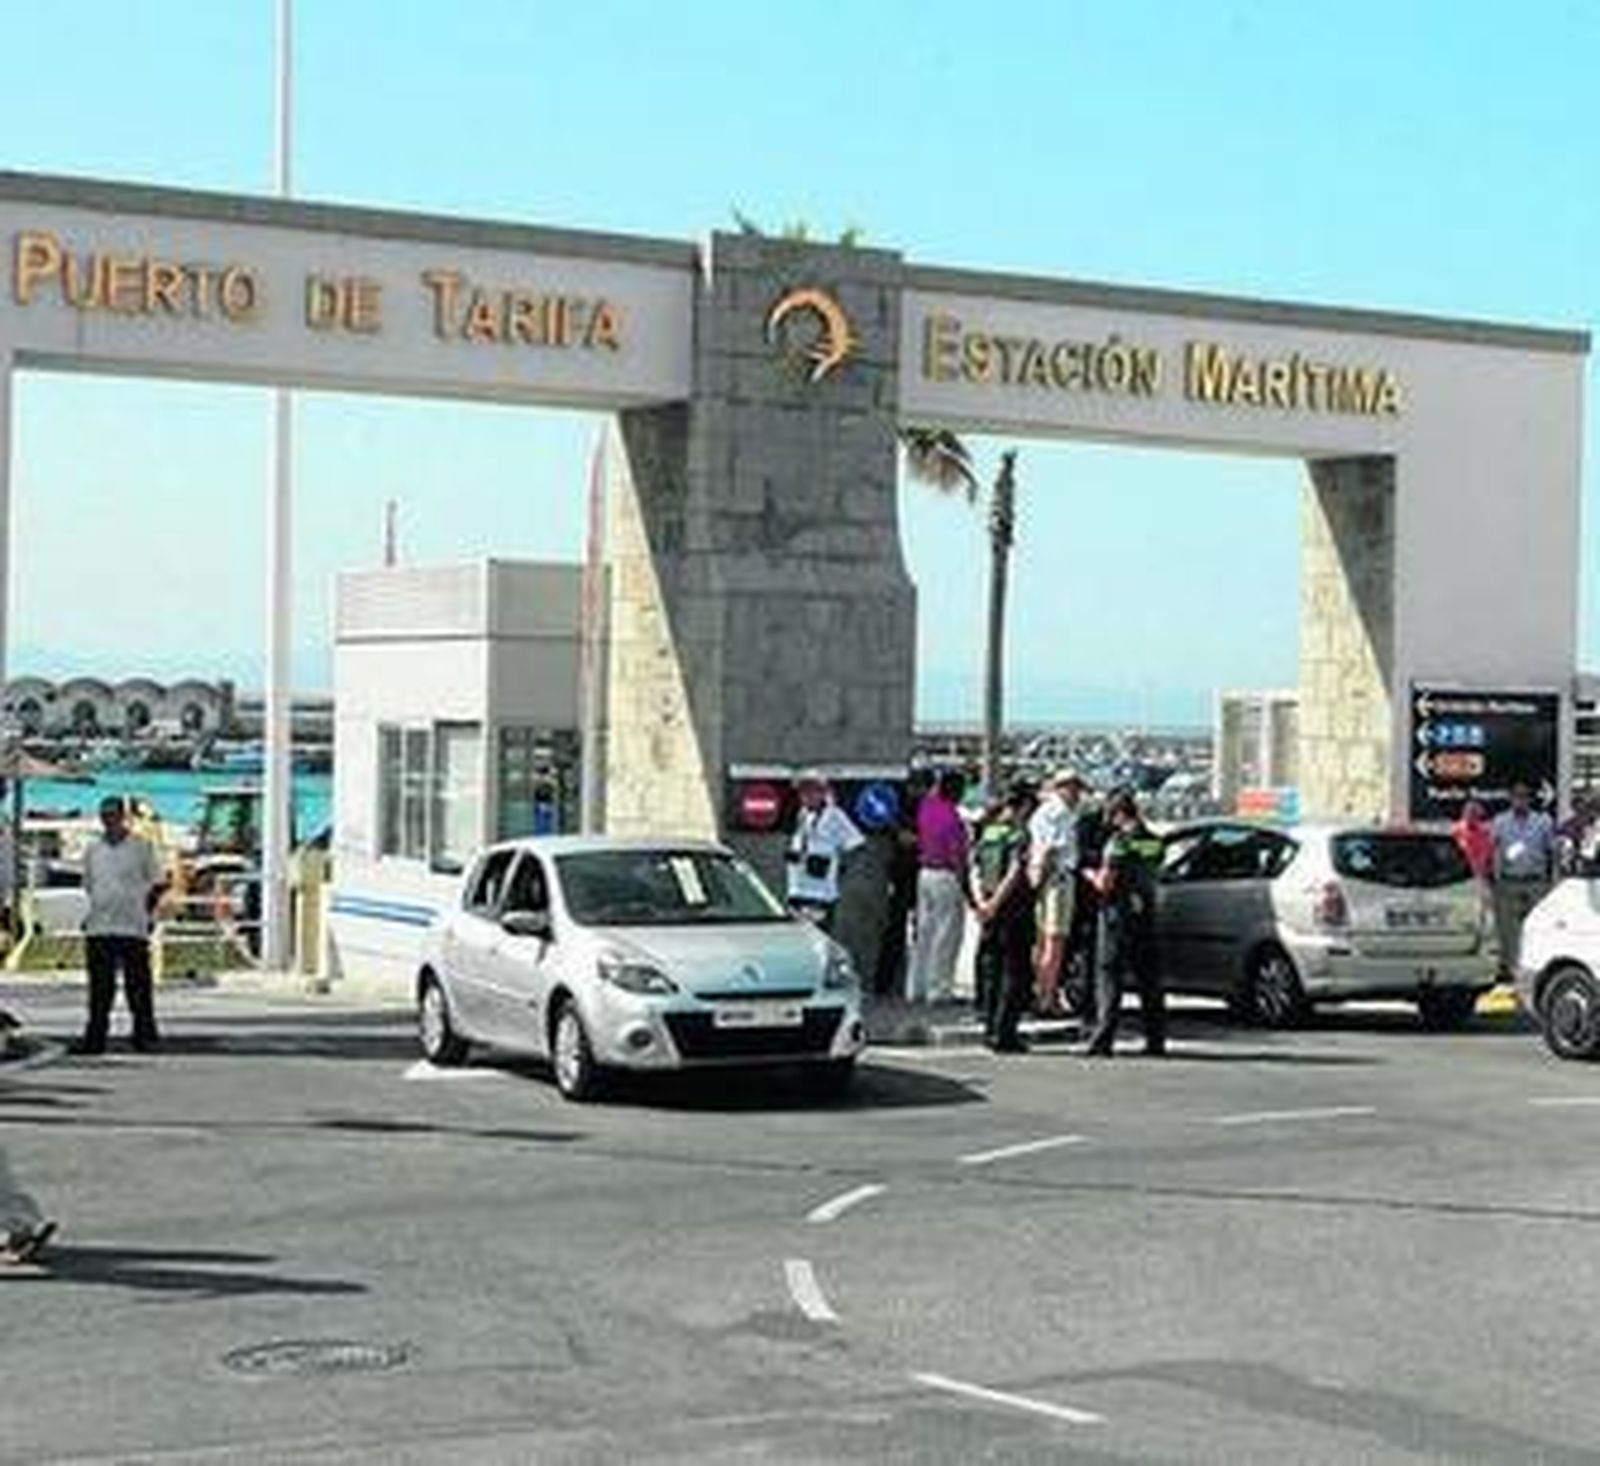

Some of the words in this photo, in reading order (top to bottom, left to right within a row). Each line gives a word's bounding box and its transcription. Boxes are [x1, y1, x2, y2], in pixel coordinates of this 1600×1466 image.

[13, 231, 260, 321] PUERTO
[305, 272, 383, 333] DE
[421, 269, 619, 352] TARIFA
[922, 308, 1159, 396] ESTACIÓN
[1185, 341, 1404, 418] MARÍTIMA
